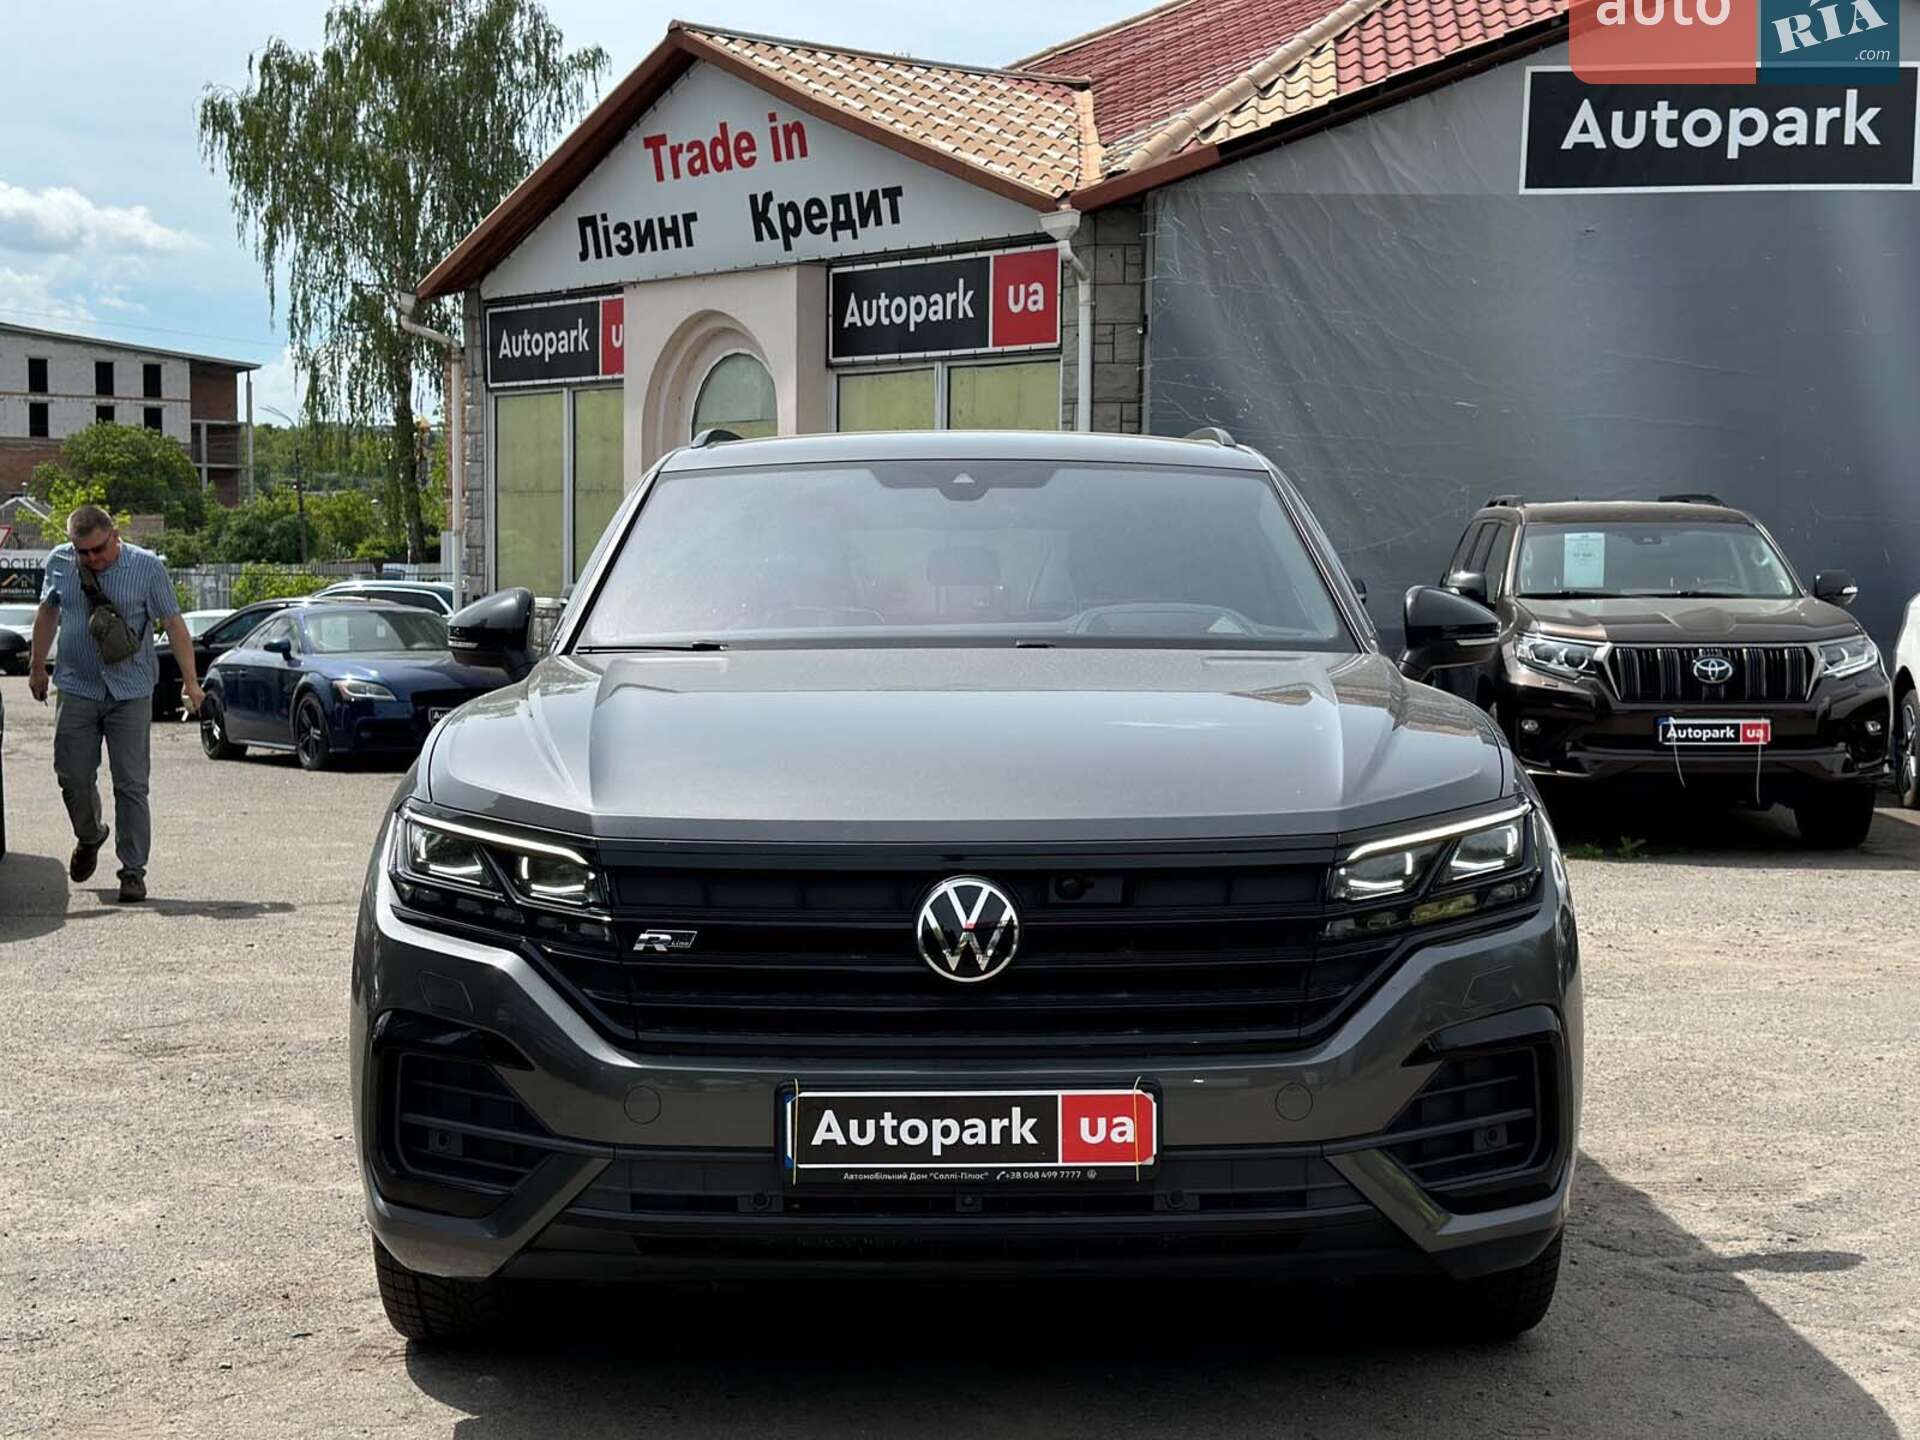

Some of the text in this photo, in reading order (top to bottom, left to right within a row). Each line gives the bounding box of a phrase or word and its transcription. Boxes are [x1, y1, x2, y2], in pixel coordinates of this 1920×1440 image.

[643, 112, 809, 182] Trade in
[1560, 88, 1882, 160] Autopark
[577, 185, 903, 262] Лізинг Кредит
[843, 278, 1046, 333] Autopark ua
[498, 318, 590, 363] Autopark
[1666, 726, 1764, 741] Autopark ua
[810, 1107, 1135, 1156] Autopark ua
